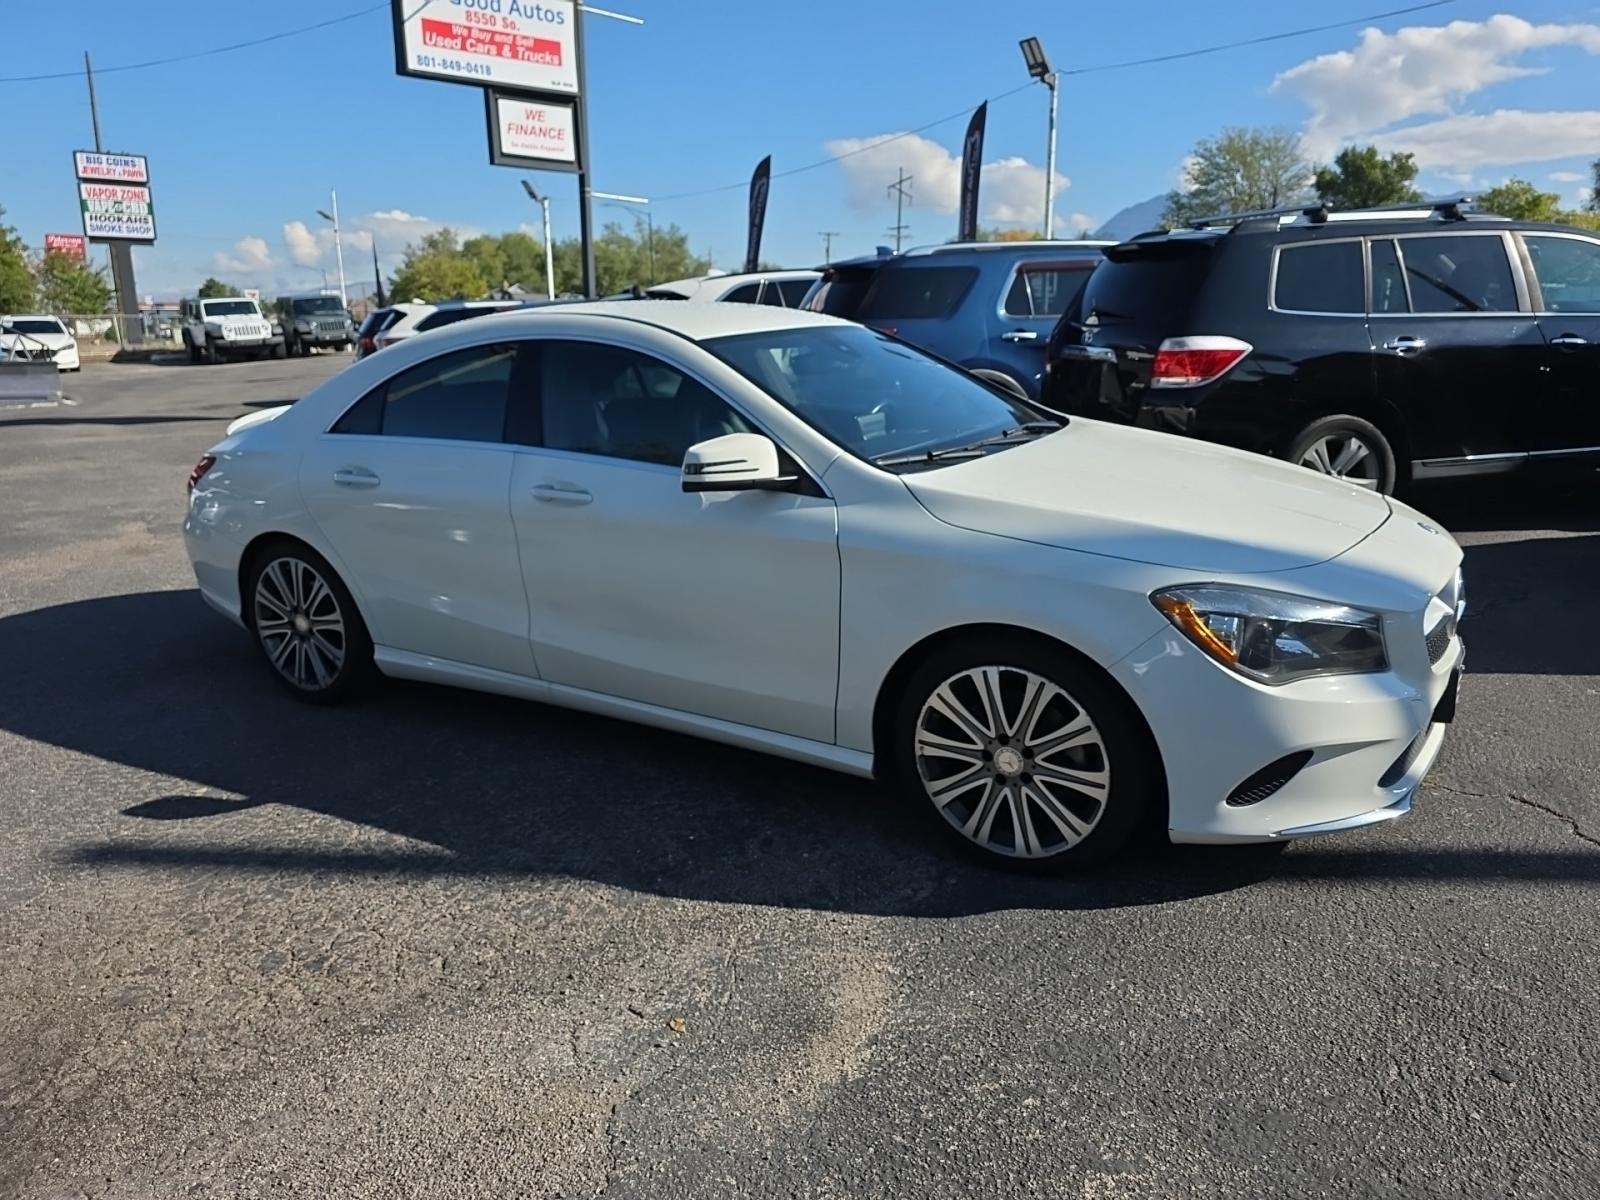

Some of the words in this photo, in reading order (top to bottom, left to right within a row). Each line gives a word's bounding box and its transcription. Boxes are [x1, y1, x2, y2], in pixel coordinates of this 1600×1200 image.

[464, 10, 497, 27] 8550
[502, 16, 521, 32] So.
[509, 0, 565, 25] Autos
[452, 24, 469, 36] We
[471, 28, 492, 41] Buy
[494, 34, 514, 45] and
[515, 37, 535, 48] Sell
[425, 31, 462, 50] Used
[465, 38, 499, 57] Cars
[501, 45, 513, 58] &
[517, 48, 561, 66] Trucks
[416, 54, 493, 76] 801-849-0418
[525, 108, 546, 122] WE
[507, 123, 566, 141] FINANCE
[86, 155, 103, 165] BIG
[106, 157, 137, 167] COINS
[85, 186, 118, 199] VAPOR
[120, 189, 145, 202] ZONE
[89, 214, 150, 225] HOOKAHS
[89, 224, 122, 233] SMOKE
[126, 226, 152, 235] SHOP
